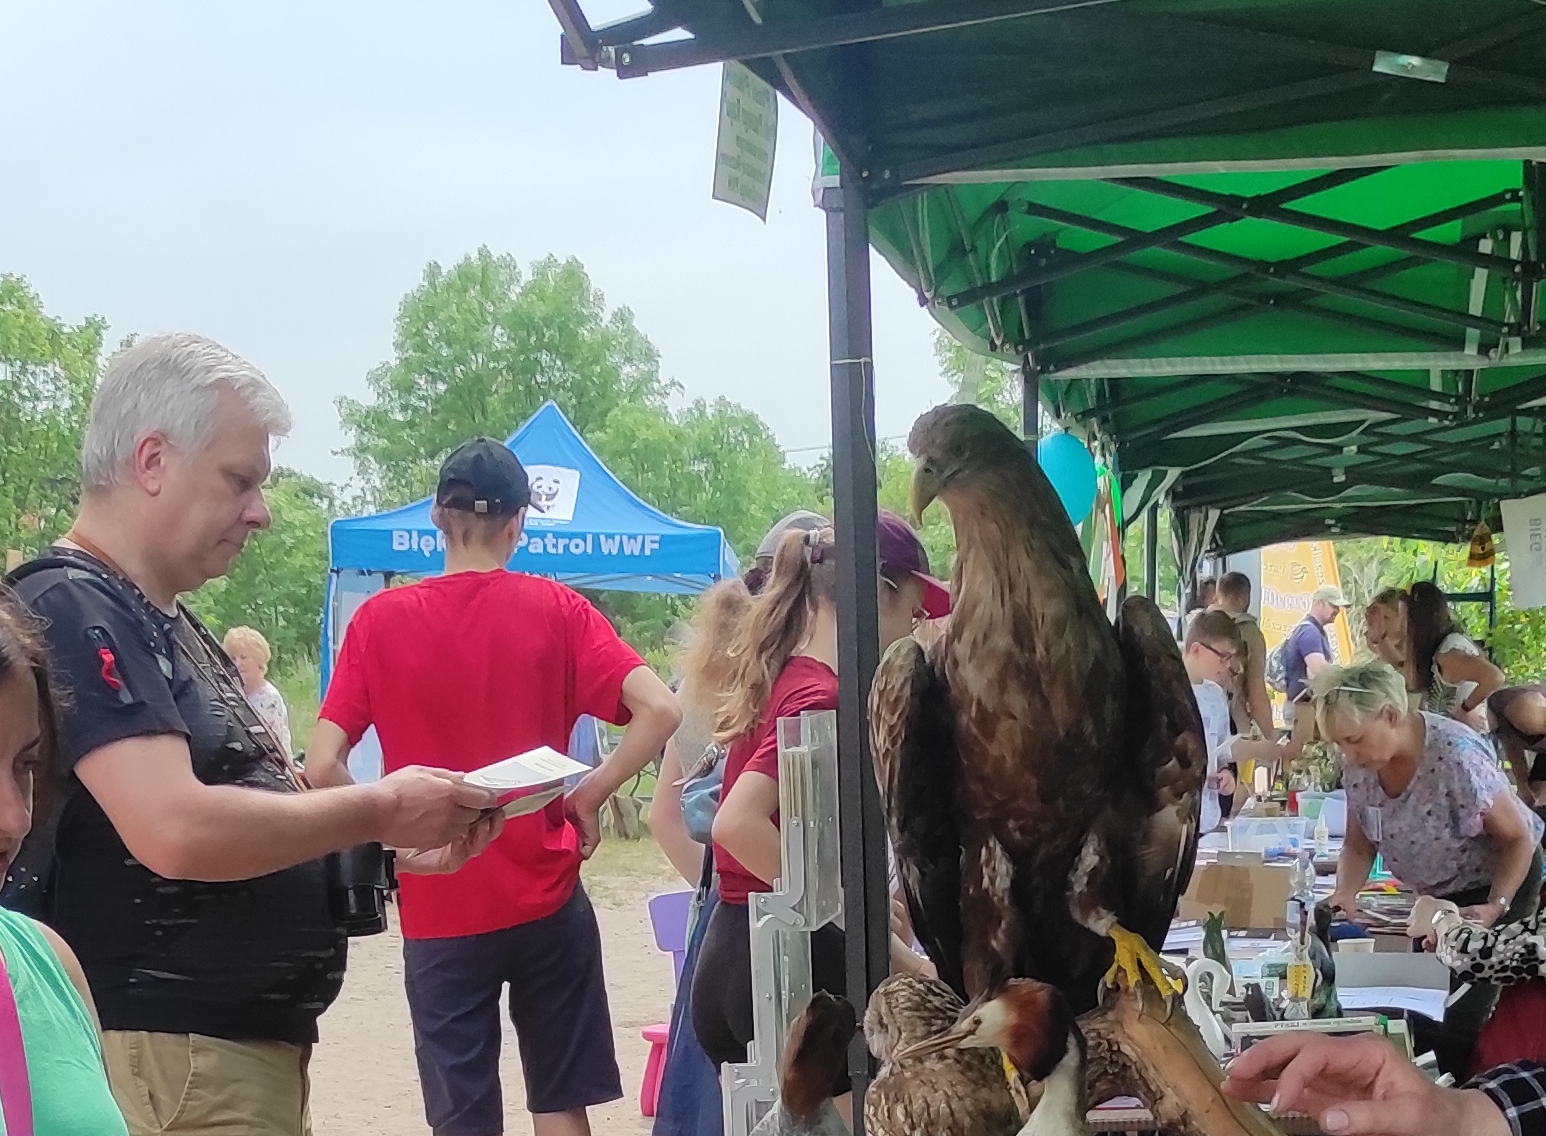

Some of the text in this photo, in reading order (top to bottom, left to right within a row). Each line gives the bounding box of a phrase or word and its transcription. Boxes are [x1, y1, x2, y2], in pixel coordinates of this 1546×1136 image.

[392, 530, 662, 557] Błęk Patrol WWF
